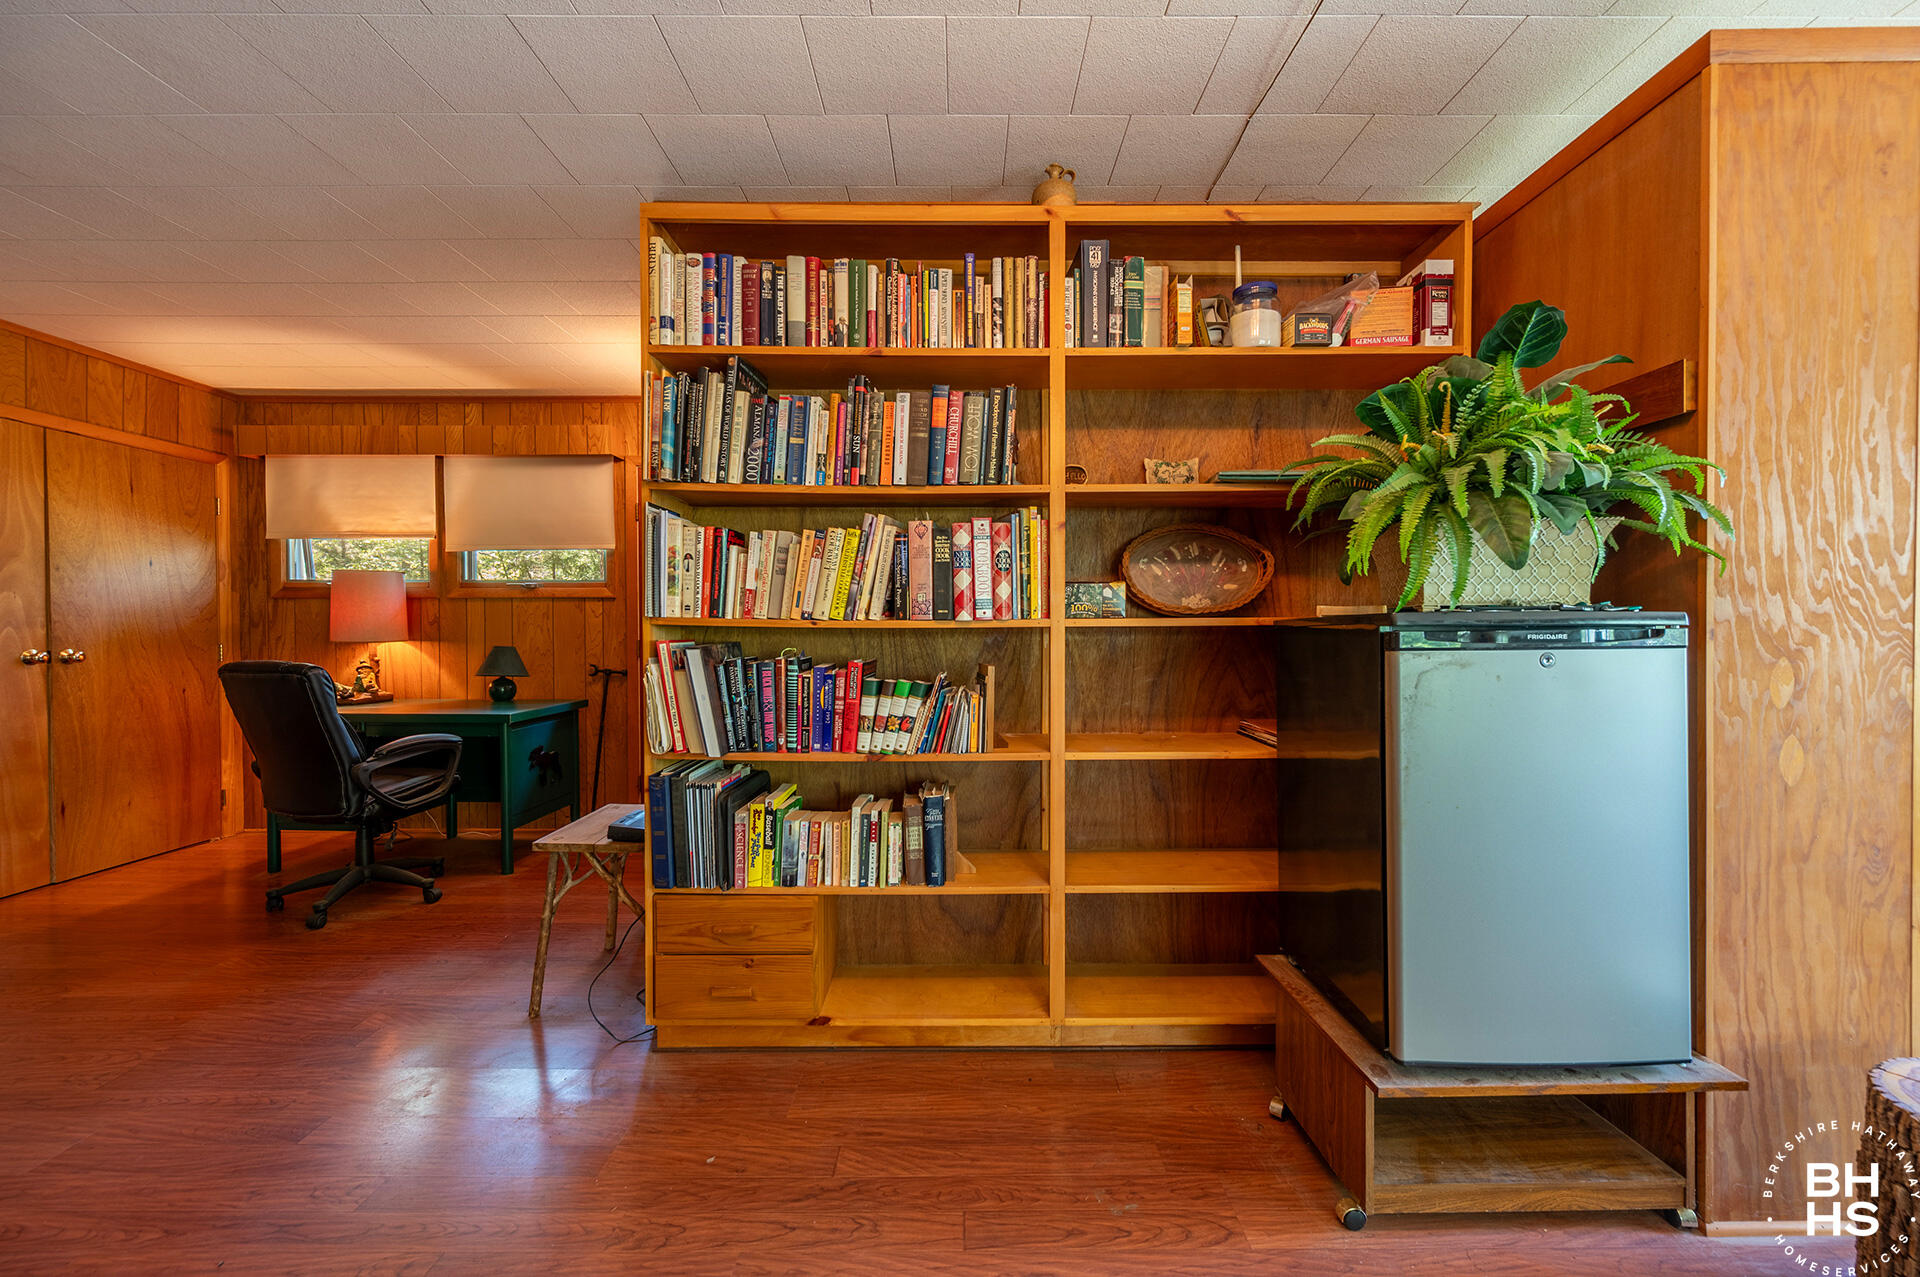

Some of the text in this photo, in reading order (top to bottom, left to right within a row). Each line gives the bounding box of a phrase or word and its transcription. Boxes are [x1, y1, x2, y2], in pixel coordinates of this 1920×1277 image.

[648, 242, 657, 275] BIRDS
[693, 293, 700, 302] OF
[706, 269, 714, 318] TOM BROKAW
[1382, 336, 1409, 344] SAUSAGE
[663, 384, 672, 413] NATURE
[726, 384, 734, 404] ATLAS
[725, 405, 731, 414] OF
[992, 395, 1001, 428] Encyclopedia
[723, 416, 731, 439] WORLD
[793, 413, 804, 436] PRIZE
[947, 407, 960, 455] CHURCHILL
[720, 440, 729, 468] HISTORY
[852, 435, 860, 454] SUN
[882, 426, 891, 466] STALINGRAD
[745, 448, 759, 481] 2000
[989, 459, 997, 479] Making
[824, 530, 836, 572] GOURMET
[976, 541, 989, 597] COOKBOOK
[1071, 603, 1098, 612] 100%
[762, 671, 774, 743] BLACK HOLES & TIME WARPS
[765, 815, 773, 845] Baseball
[736, 832, 744, 868] SCIENCE
